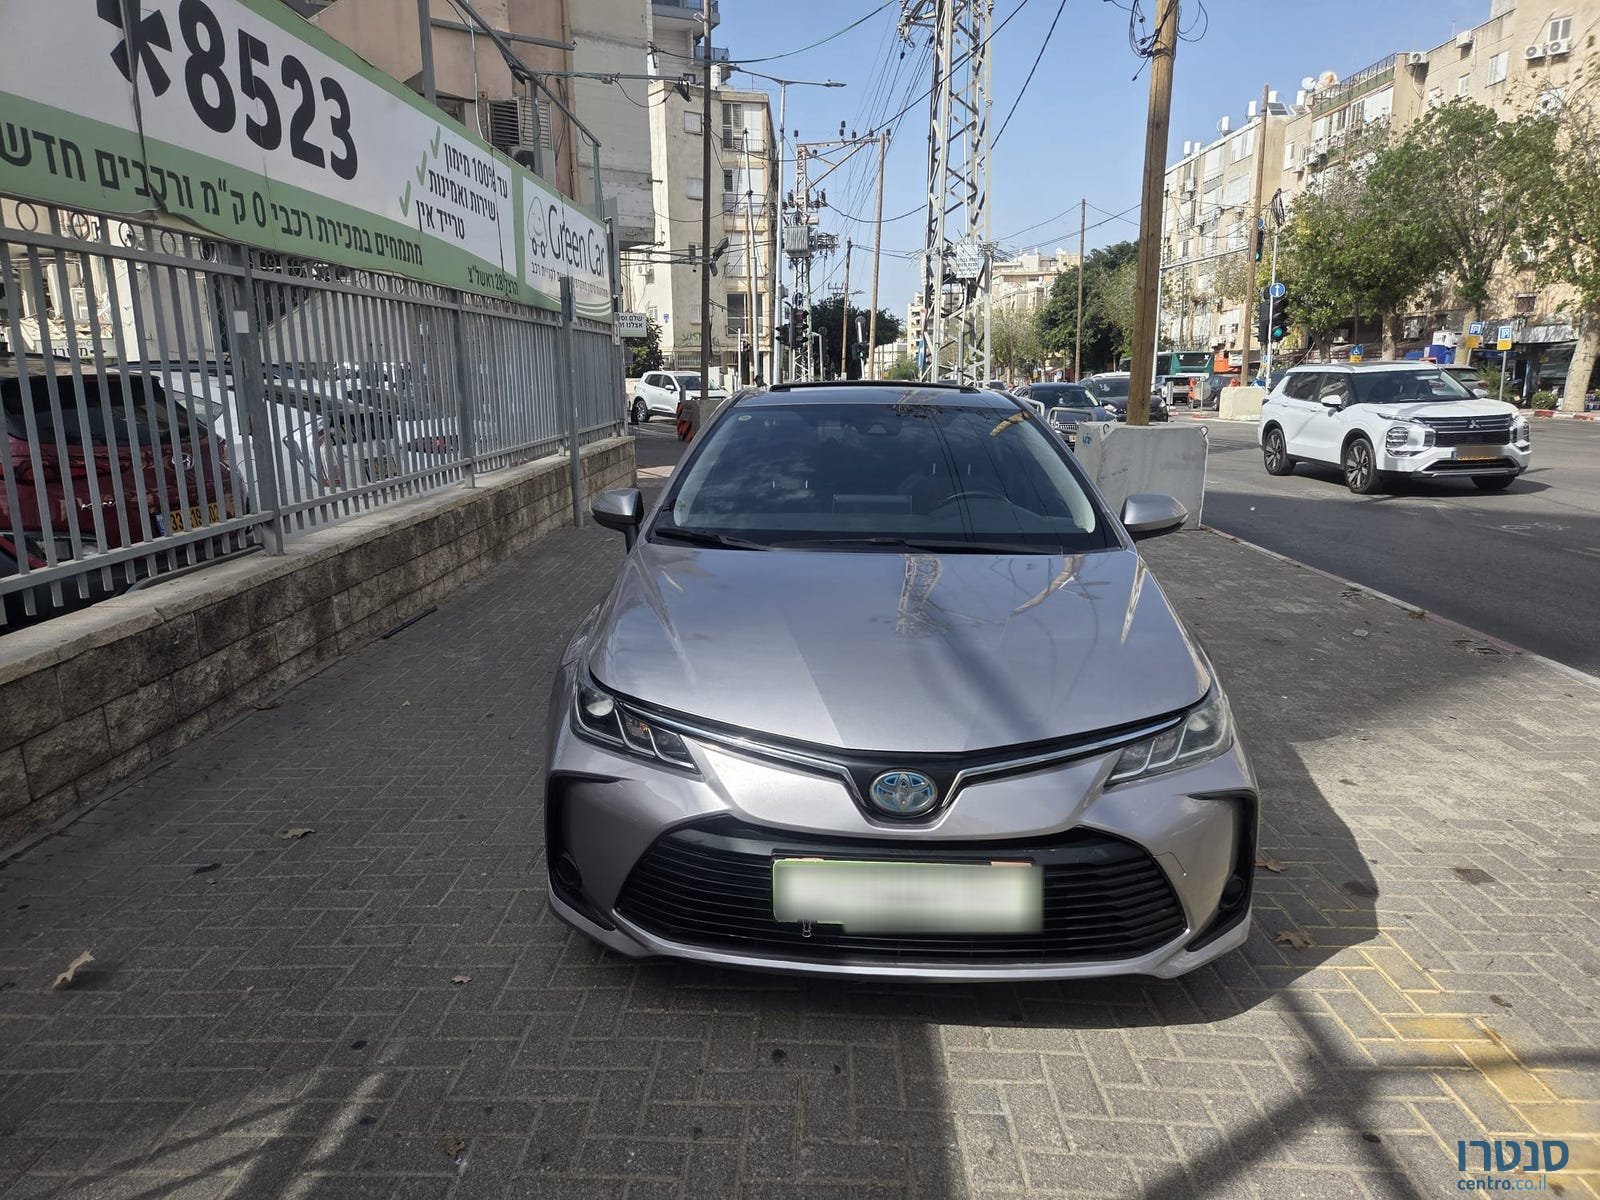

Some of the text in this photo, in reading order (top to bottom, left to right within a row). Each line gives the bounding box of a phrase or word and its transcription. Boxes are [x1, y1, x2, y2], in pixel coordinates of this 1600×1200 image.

[95, 149, 194, 210] ורכבים
[428, 169, 496, 221] שירות ואמינות
[444, 143, 508, 199] עד 100% מימון
[200, 177, 246, 225] ק"מ
[271, 202, 314, 240] רכבי
[416, 200, 465, 239] טרייד אין
[316, 215, 373, 254] במכירת
[374, 232, 423, 265] מתמחים
[548, 204, 605, 277] Green Car
